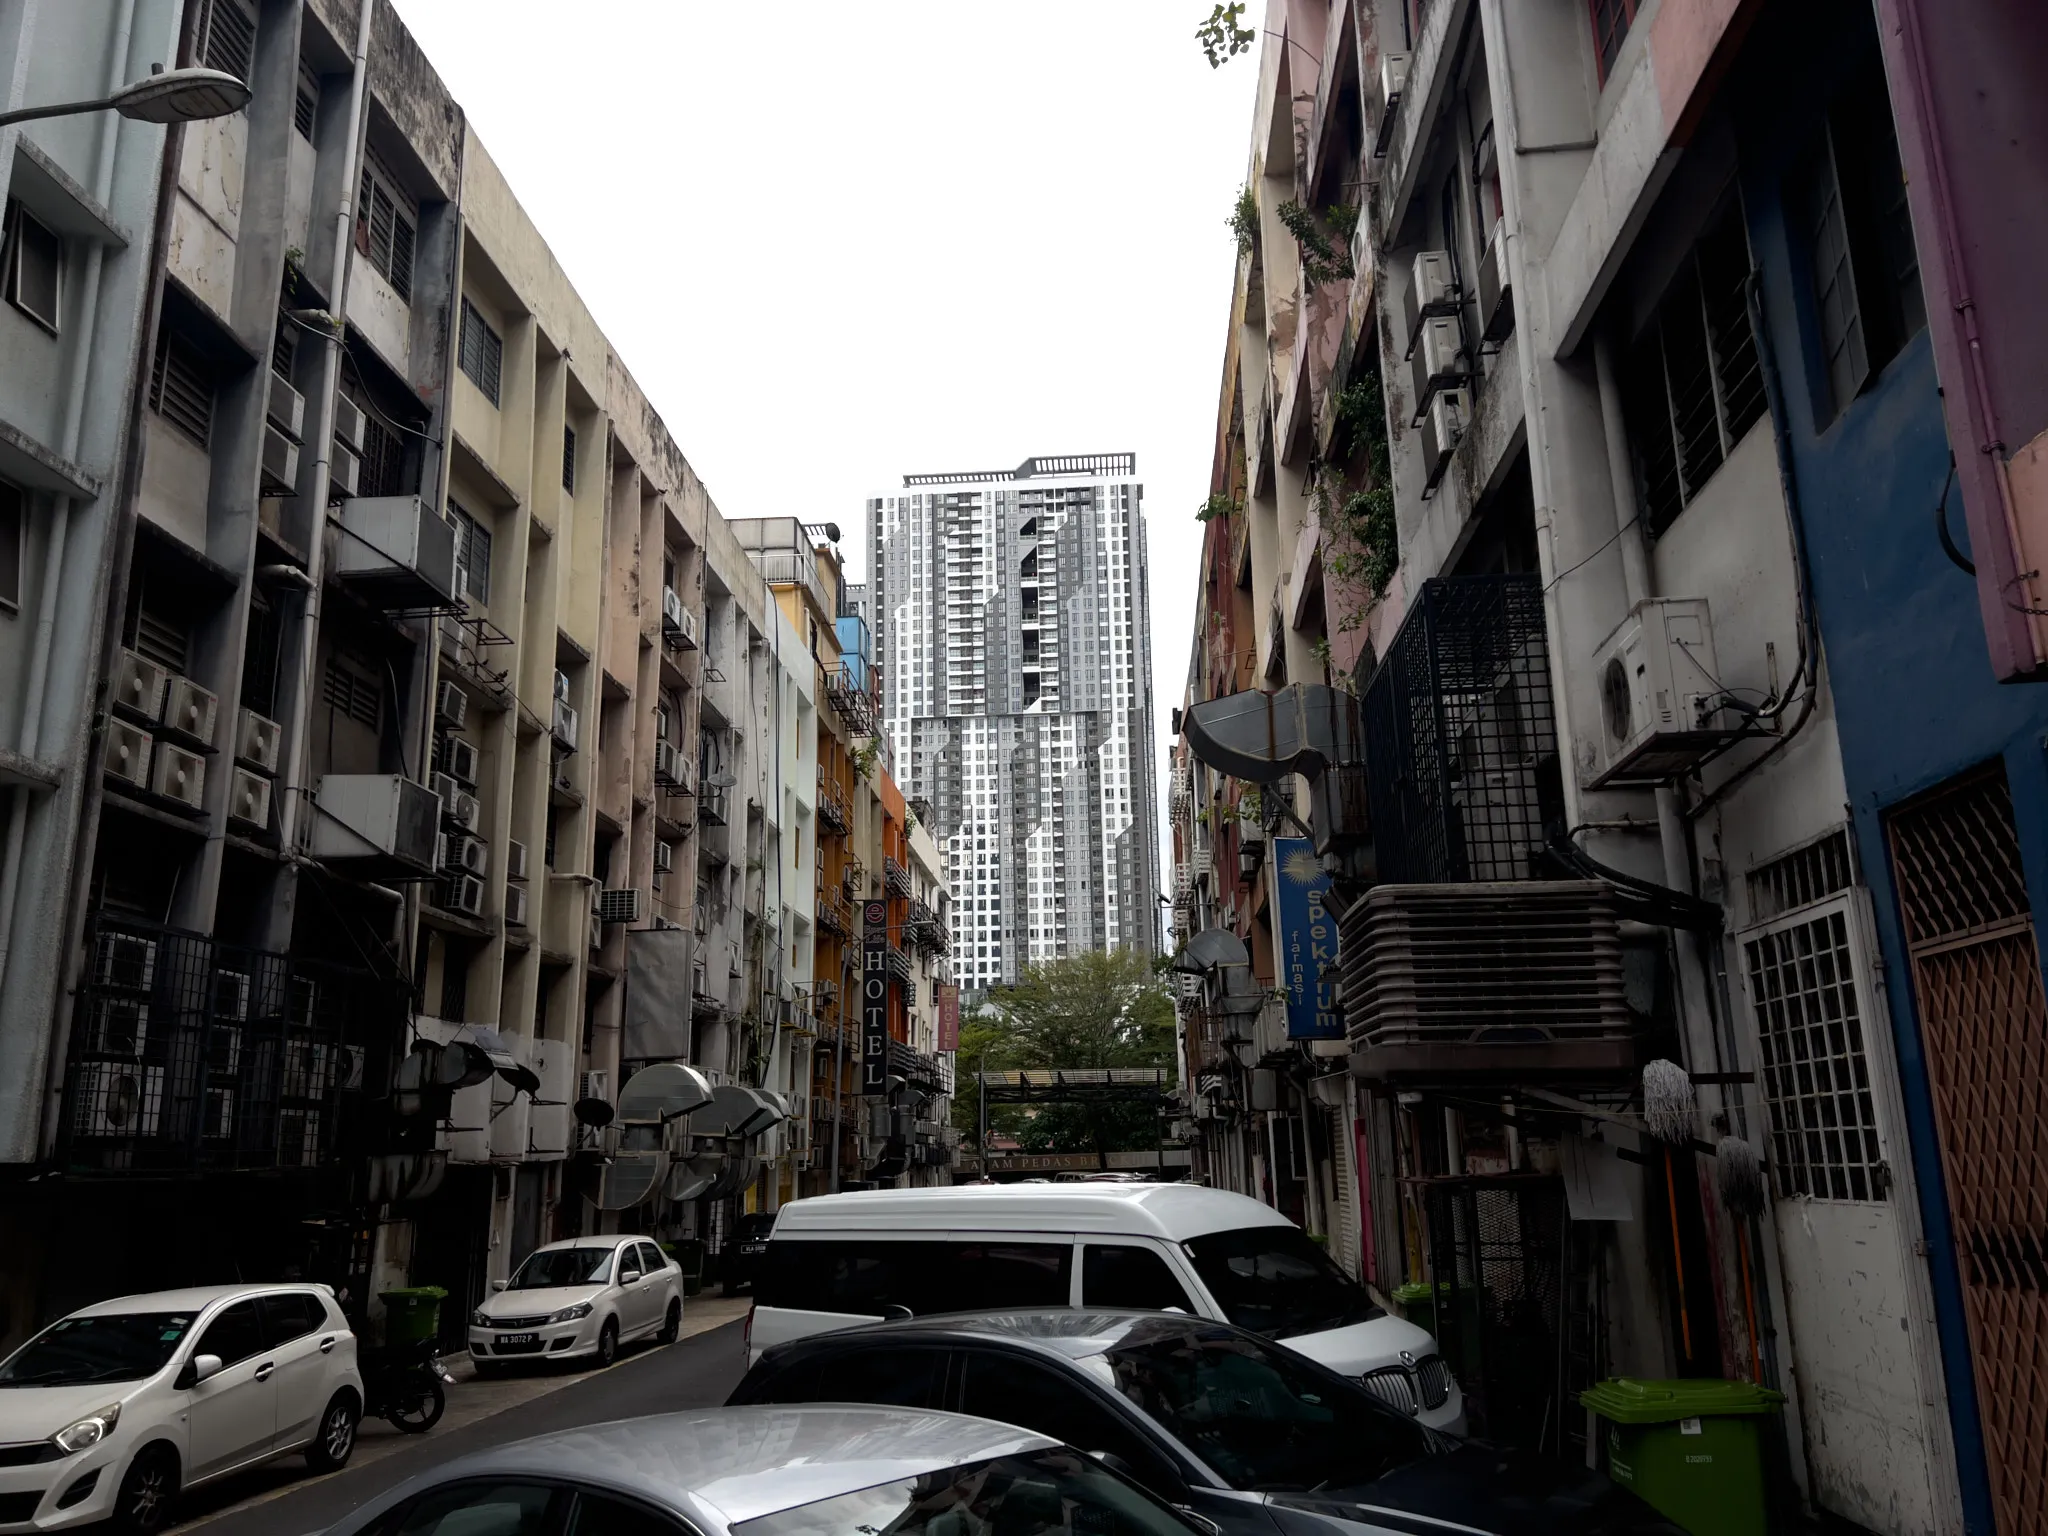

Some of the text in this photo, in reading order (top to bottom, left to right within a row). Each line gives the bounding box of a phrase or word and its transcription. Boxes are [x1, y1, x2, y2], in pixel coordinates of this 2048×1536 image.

[1291, 931, 1304, 1005] farmasi
[1307, 890, 1337, 1026] spektrum
[865, 951, 885, 1085] HOTEL
[944, 1003, 953, 1049] HOTEL
[970, 1158, 1013, 1170] AAM
[1022, 1156, 1071, 1168] PEDAS
[510, 1335, 526, 1343] 3072
[527, 1335, 532, 1343] P
